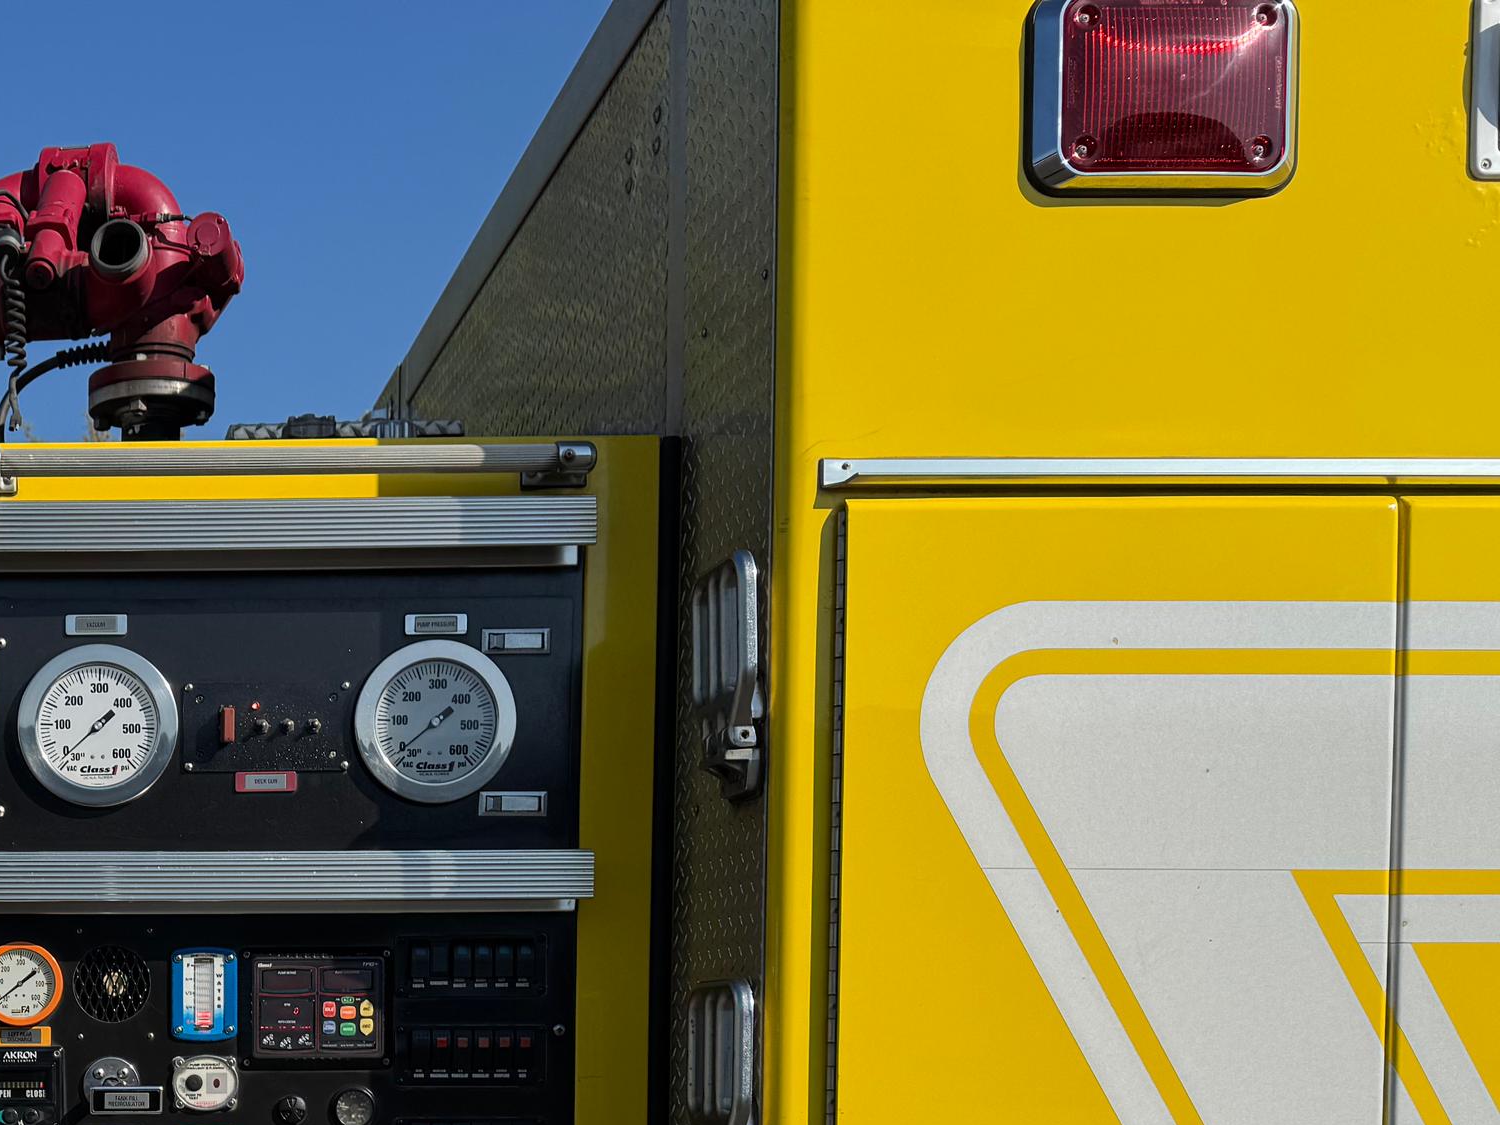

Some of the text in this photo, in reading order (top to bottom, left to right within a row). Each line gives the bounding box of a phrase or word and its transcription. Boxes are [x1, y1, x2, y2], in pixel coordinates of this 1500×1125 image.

[90, 683, 109, 693] 300
[429, 679, 448, 689] 300
[65, 696, 84, 706] 200
[402, 691, 421, 702] 200
[452, 694, 471, 704] 400
[113, 698, 132, 708] 400
[54, 720, 71, 730] 100
[392, 715, 408, 725] 100
[460, 720, 479, 730] 500
[122, 724, 141, 734] 500
[112, 749, 131, 759] 600
[449, 744, 469, 755] 600
[121, 765, 130, 773] psi
[457, 761, 467, 769] psi
[3, 1051, 37, 1059] AKRON
